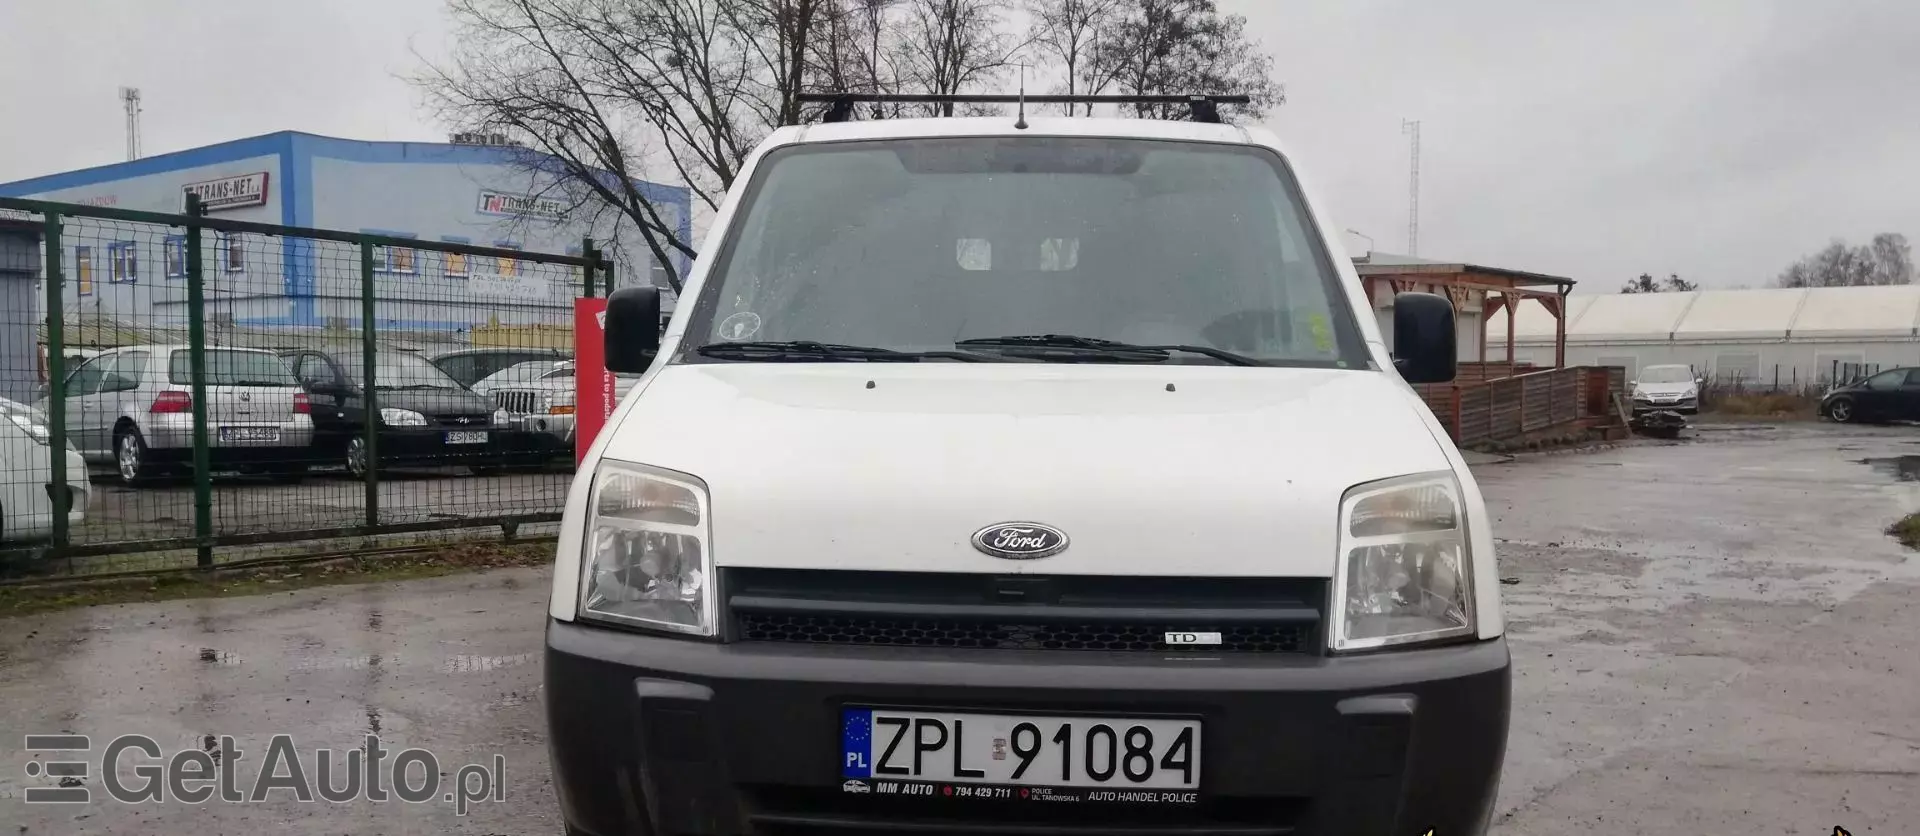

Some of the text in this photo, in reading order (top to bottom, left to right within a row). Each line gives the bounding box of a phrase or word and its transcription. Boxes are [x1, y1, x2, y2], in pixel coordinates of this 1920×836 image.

[994, 528, 1047, 548] Ford
[876, 716, 1193, 784] ZPL 91084
[846, 752, 867, 768] PL
[876, 782, 934, 796] MM AUTO
[956, 786, 1011, 799] 794 429 711
[1031, 787, 1053, 795] POLICE
[1042, 794, 1075, 803] TANOWSKA
[1088, 791, 1198, 803] AUTO HANDEL POLICE
